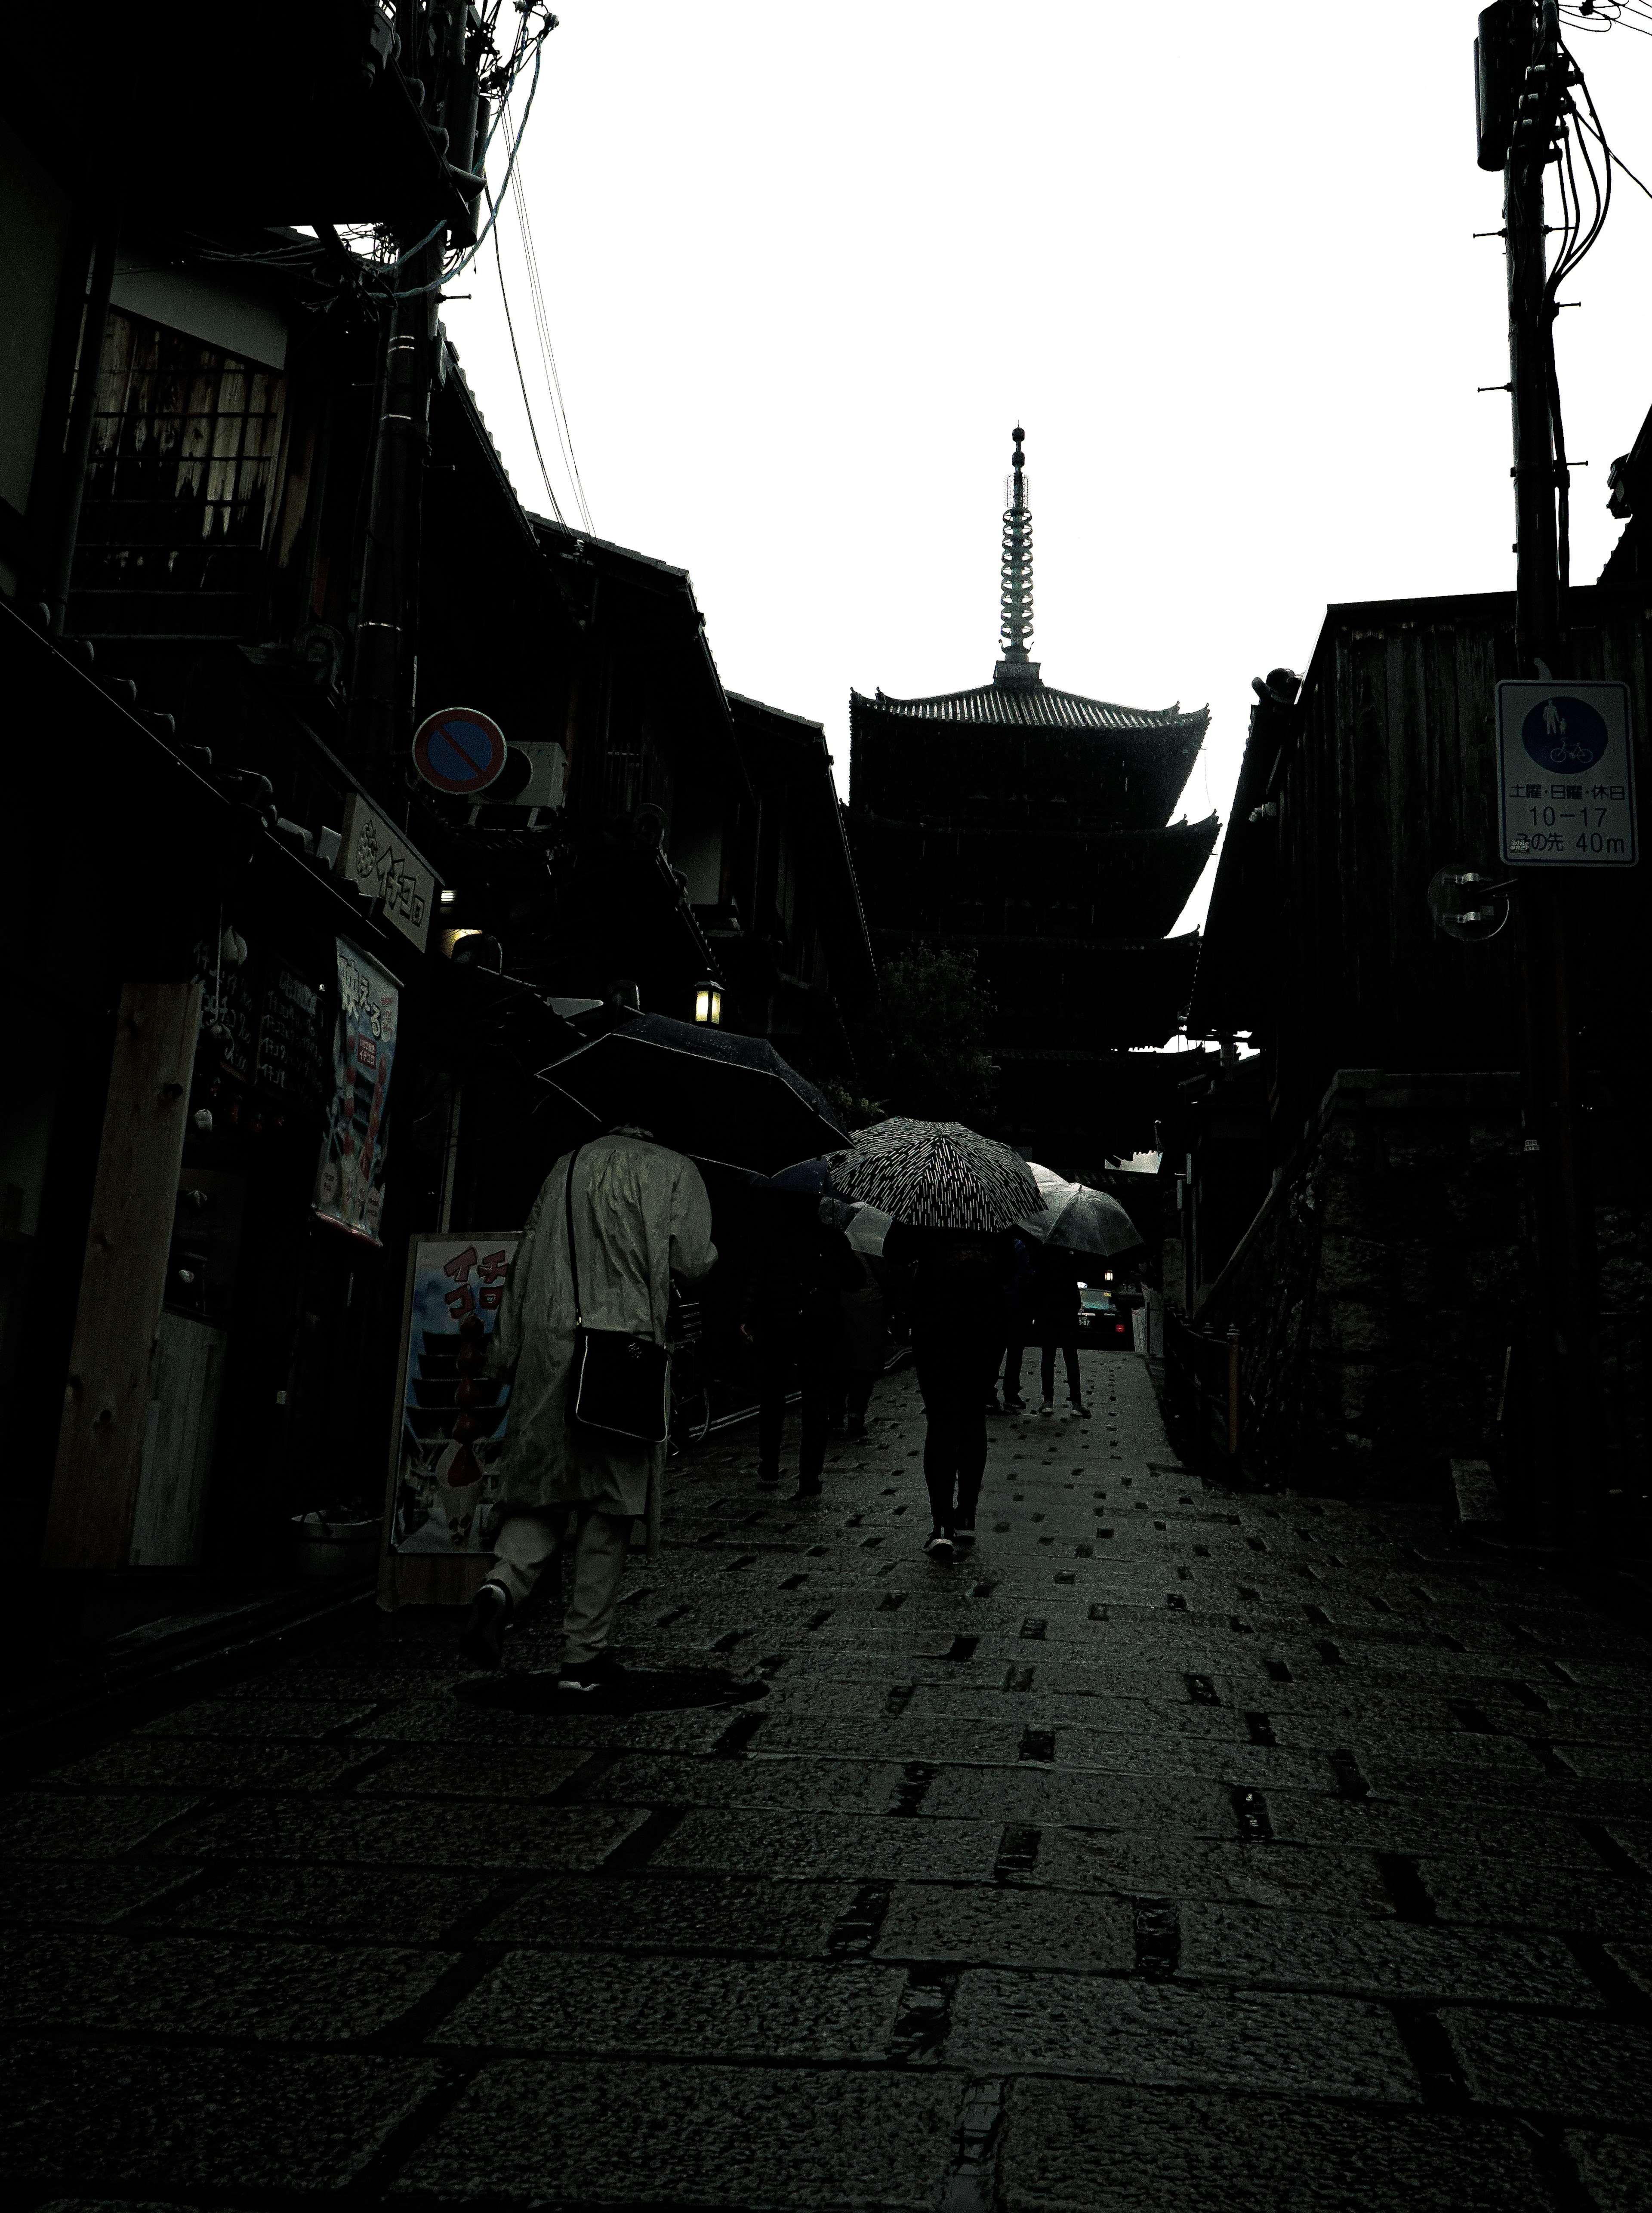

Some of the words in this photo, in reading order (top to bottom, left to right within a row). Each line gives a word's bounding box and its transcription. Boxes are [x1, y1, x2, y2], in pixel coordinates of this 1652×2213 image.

[1510, 784, 1625, 800] 土曜・日曜・休日
[1576, 832, 1624, 853] 40m
